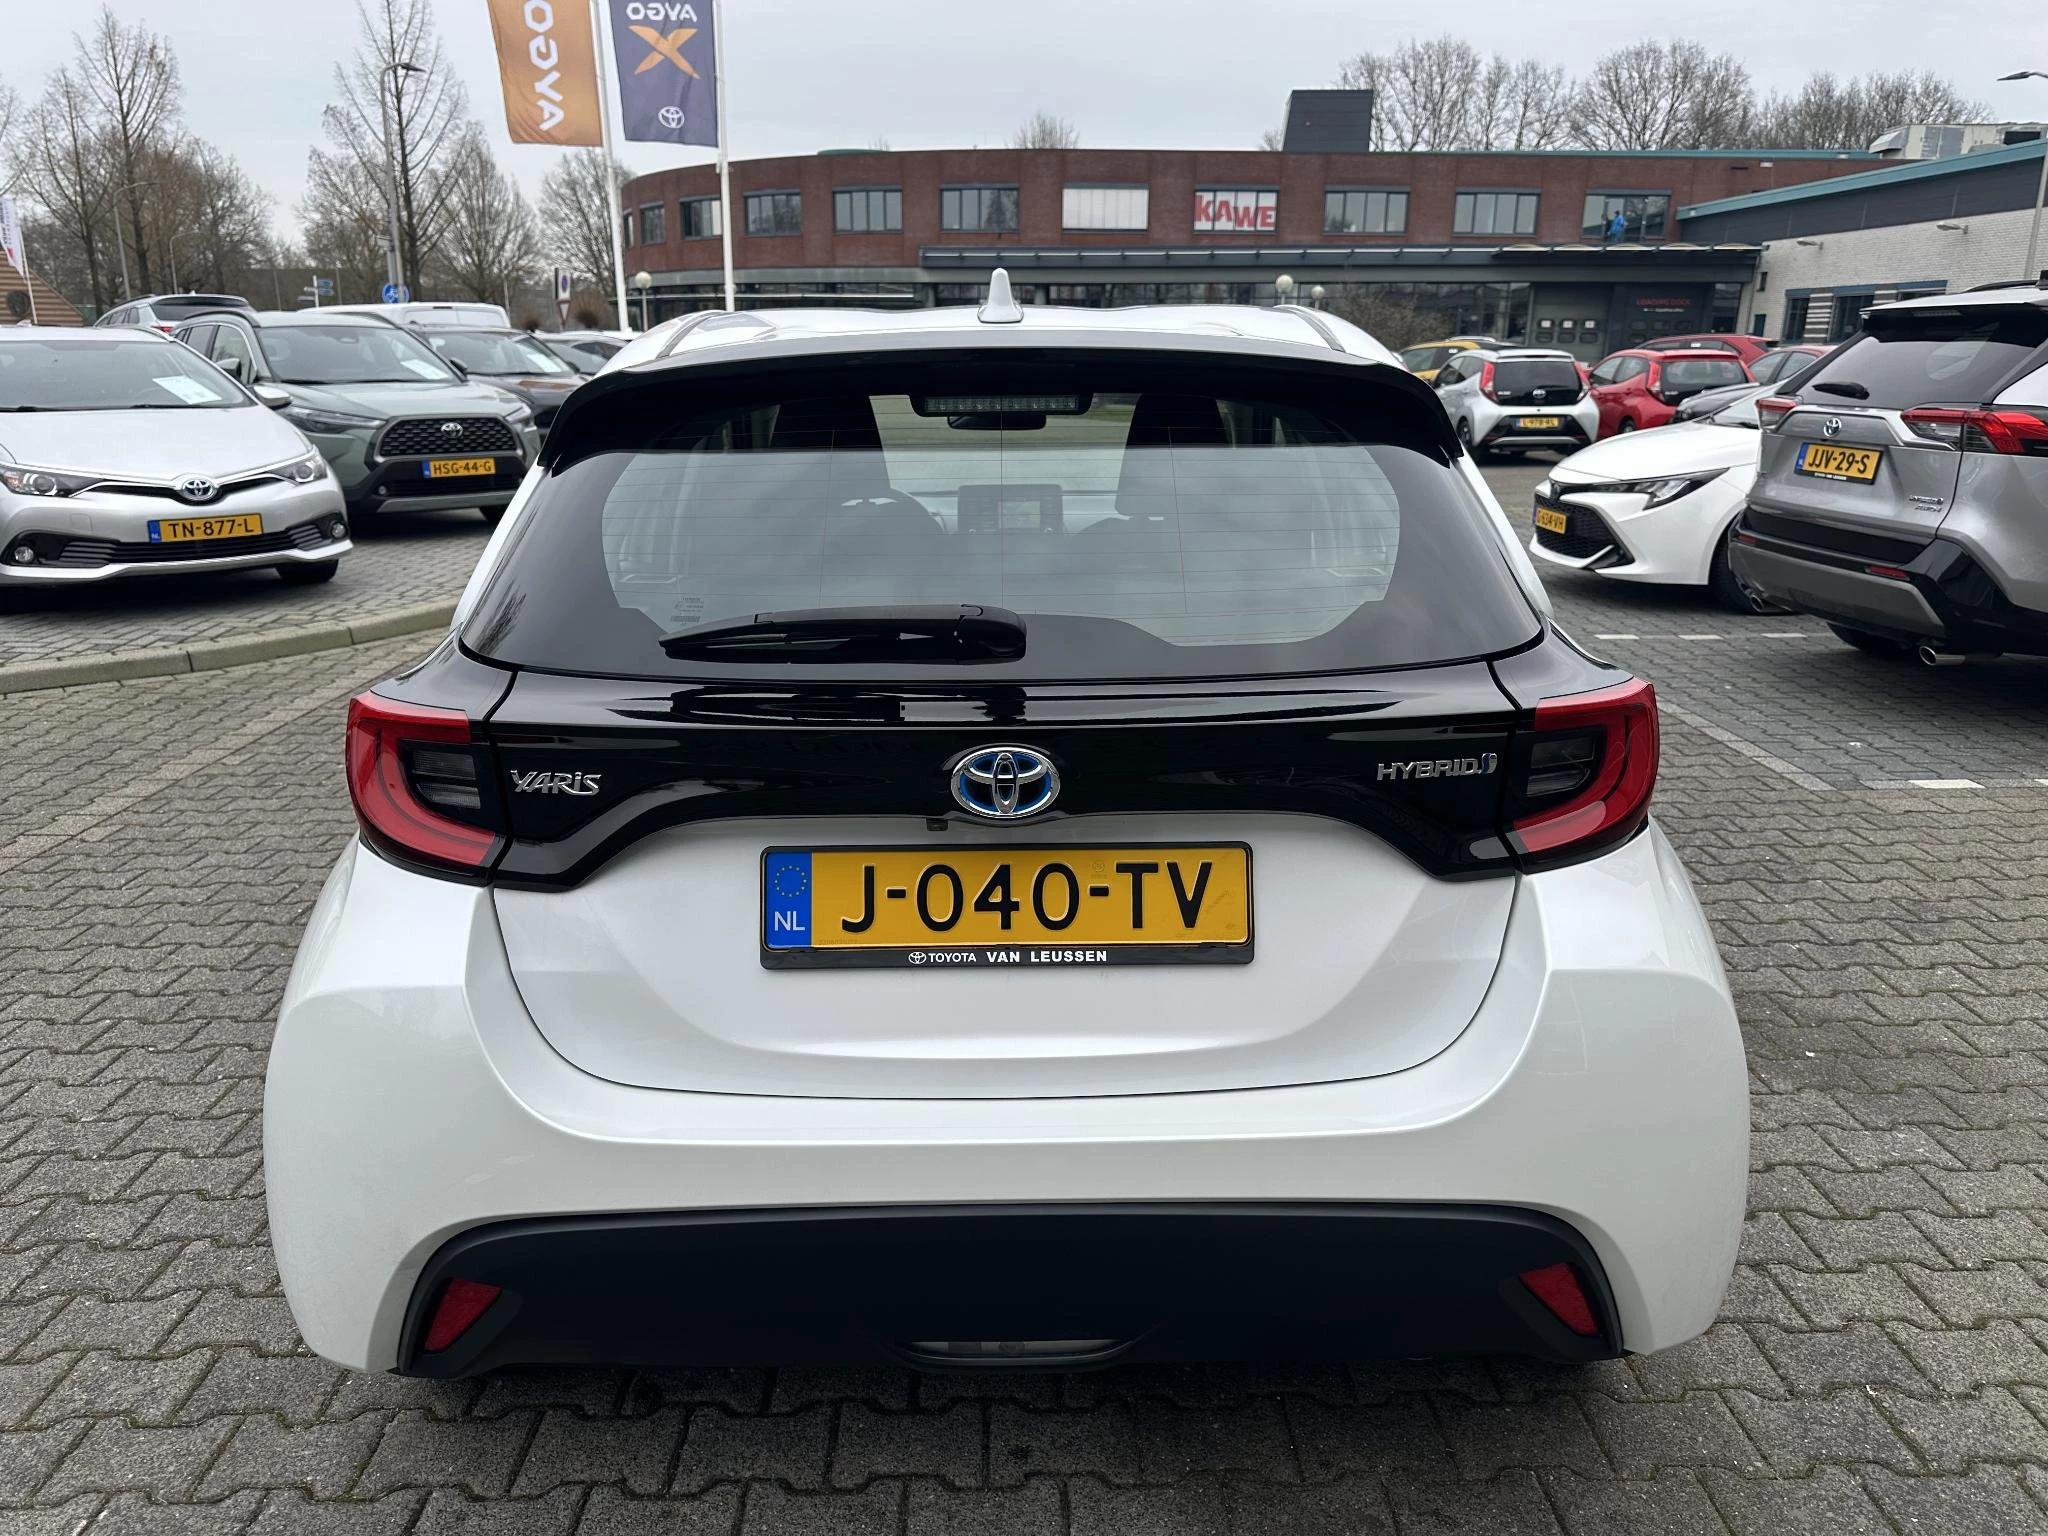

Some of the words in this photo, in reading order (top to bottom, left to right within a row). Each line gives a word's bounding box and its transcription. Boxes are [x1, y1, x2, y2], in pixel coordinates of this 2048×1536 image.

[433, 460, 491, 475] HSG-44-G
[1808, 448, 1870, 474] JJV-29-S
[168, 519, 254, 538] TN-877-L
[774, 911, 806, 931] NL
[841, 861, 1213, 932] J-040-TV
[928, 952, 977, 964] TOYOTA
[986, 951, 1020, 963] VAN
[1030, 950, 1108, 963] LEUSSEN
